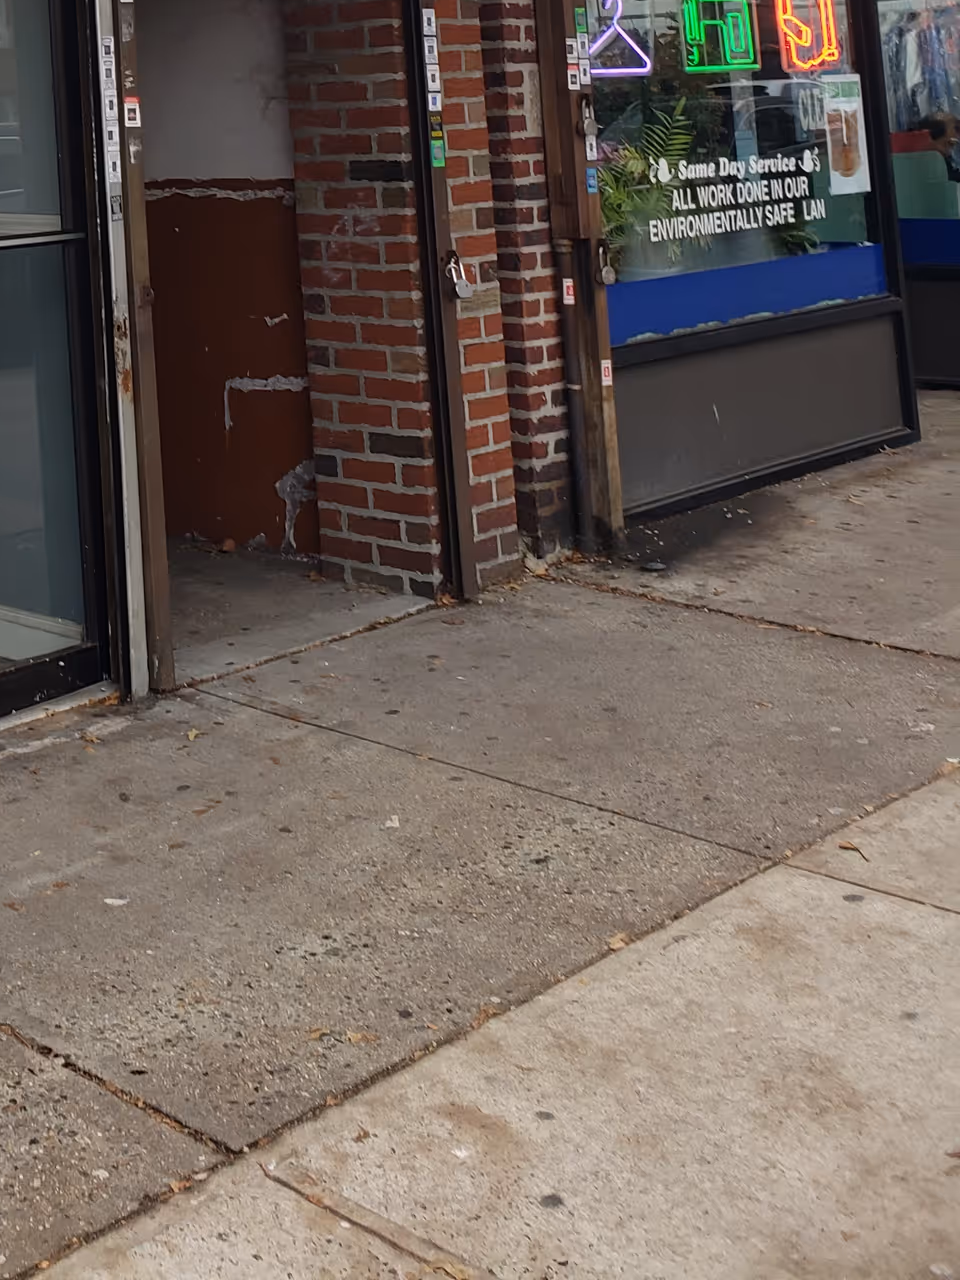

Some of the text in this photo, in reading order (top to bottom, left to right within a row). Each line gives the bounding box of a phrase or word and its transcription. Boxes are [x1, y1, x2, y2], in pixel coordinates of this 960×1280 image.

[677, 153, 797, 181] Same Day Service
[672, 175, 810, 212] ALL WORK DONE IN OUR
[649, 206, 764, 243] ENVIRONMENTALLY
[765, 202, 796, 227] SAFE
